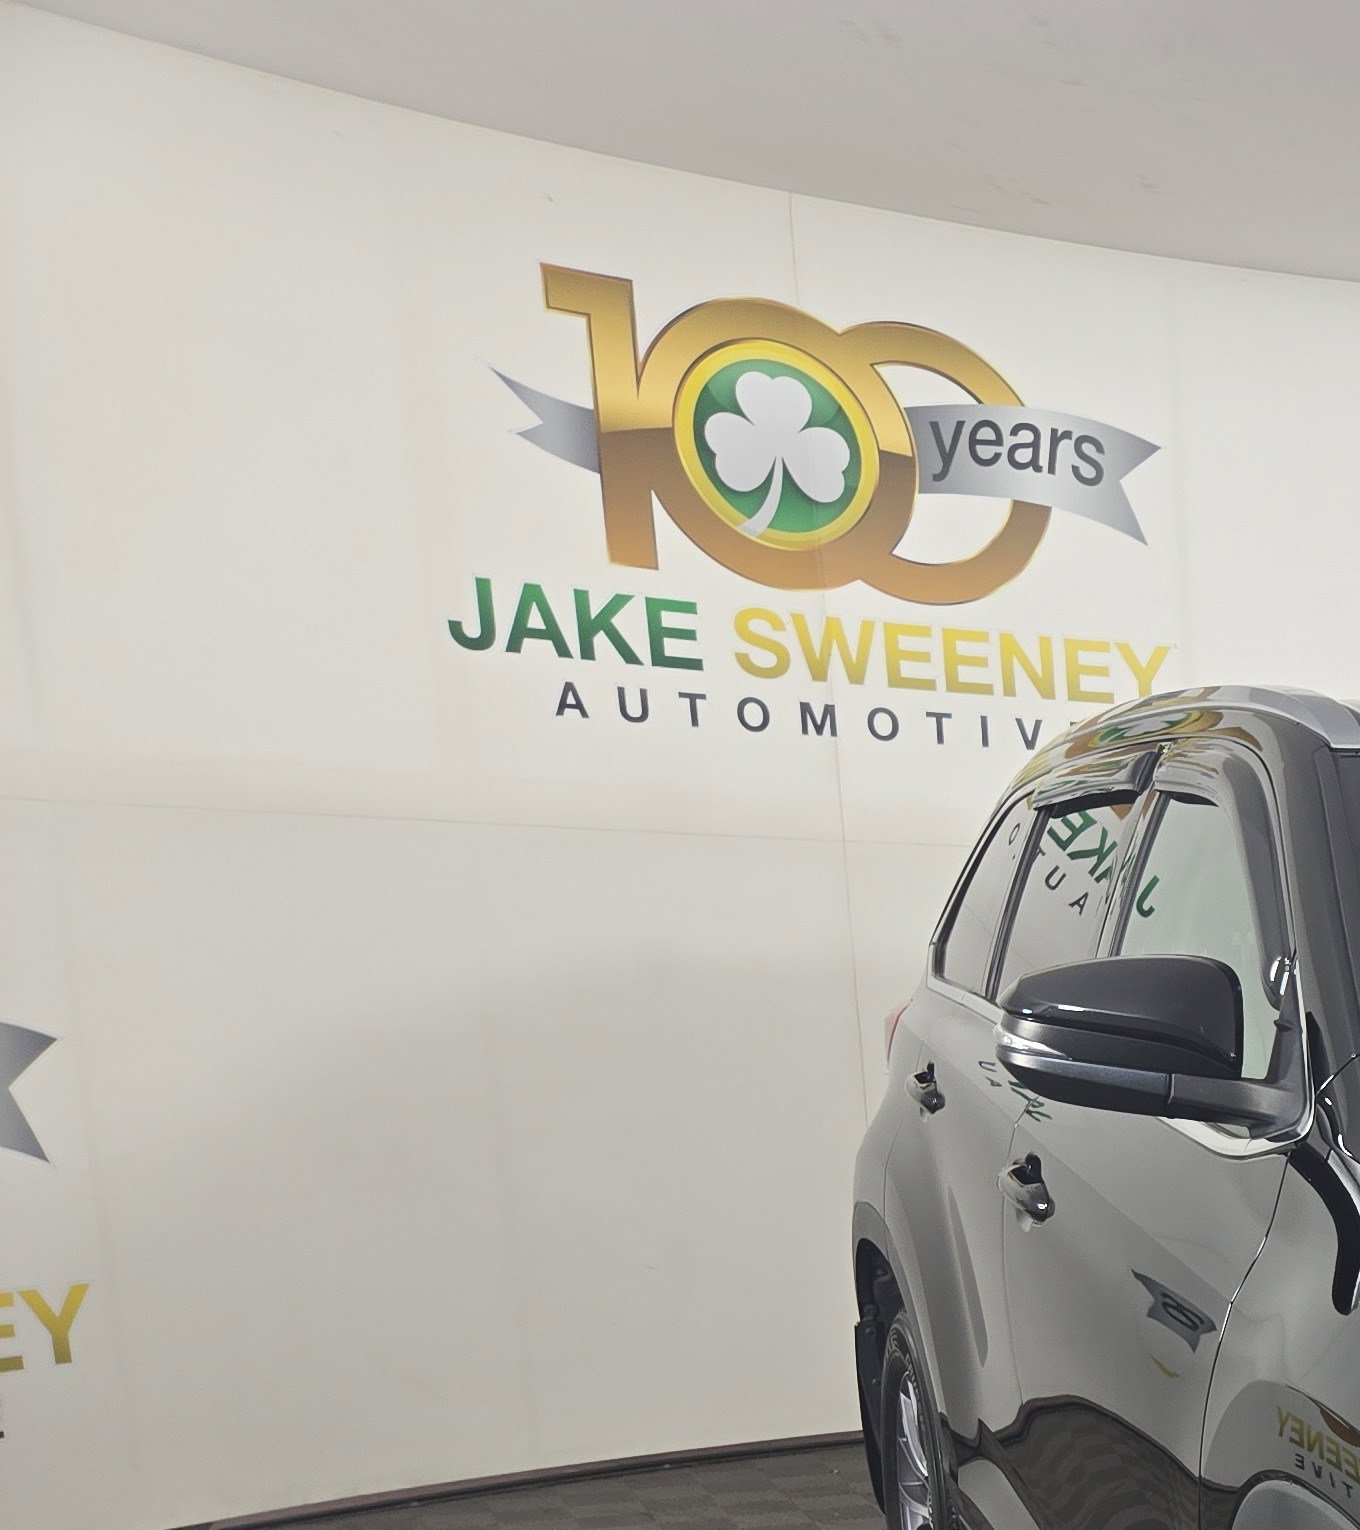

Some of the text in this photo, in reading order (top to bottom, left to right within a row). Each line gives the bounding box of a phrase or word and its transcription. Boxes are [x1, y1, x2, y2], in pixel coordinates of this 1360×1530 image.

[928, 417, 1107, 487] years
[447, 577, 1172, 704] JAKE SWEENEY
[555, 681, 1082, 751] AUTOMOTIV
